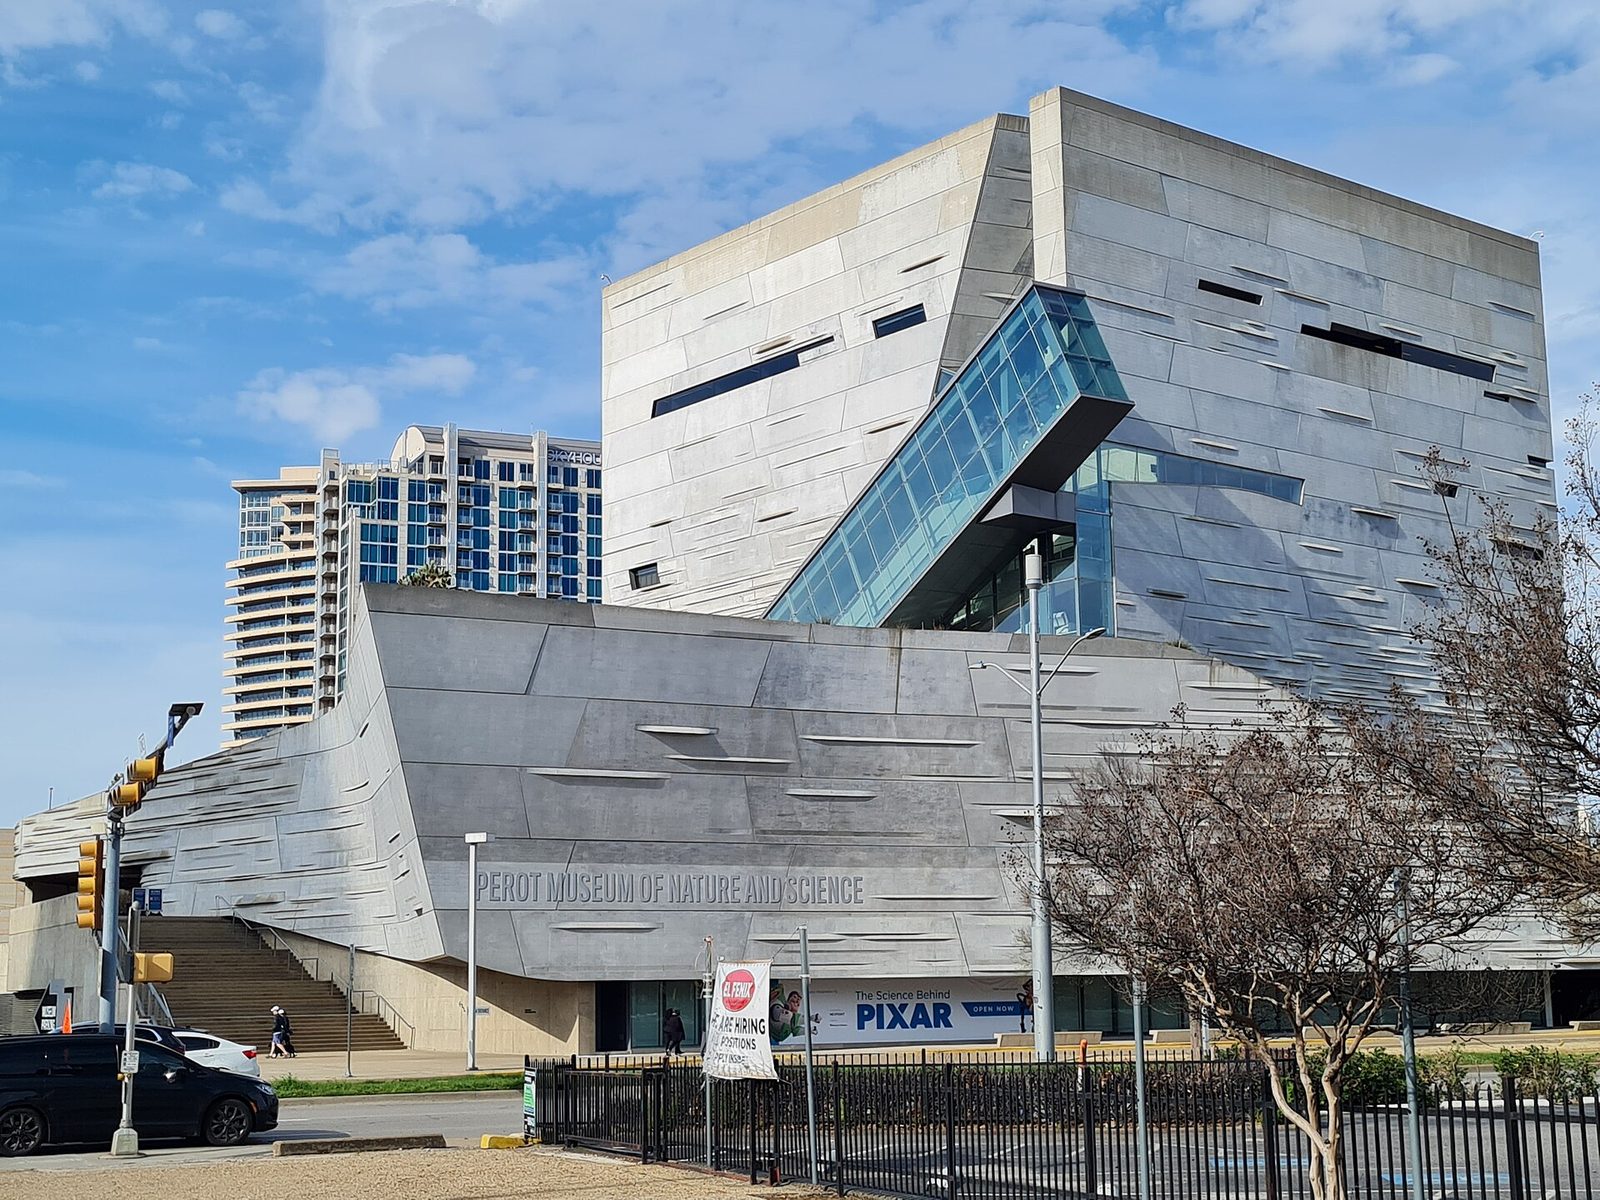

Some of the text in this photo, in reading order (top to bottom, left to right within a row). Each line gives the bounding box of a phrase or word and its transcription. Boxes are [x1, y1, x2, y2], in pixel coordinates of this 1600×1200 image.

[476, 872, 864, 904] PEROT MUSEUM OF NATURE AND SCIENCE
[732, 982, 752, 998] FENIX
[856, 989, 950, 1001] The Science Behind
[718, 1015, 734, 1033] ARE
[734, 1017, 766, 1035] HIRING
[857, 1003, 953, 1030] PIXAR
[720, 1035, 756, 1050] POSITIONS
